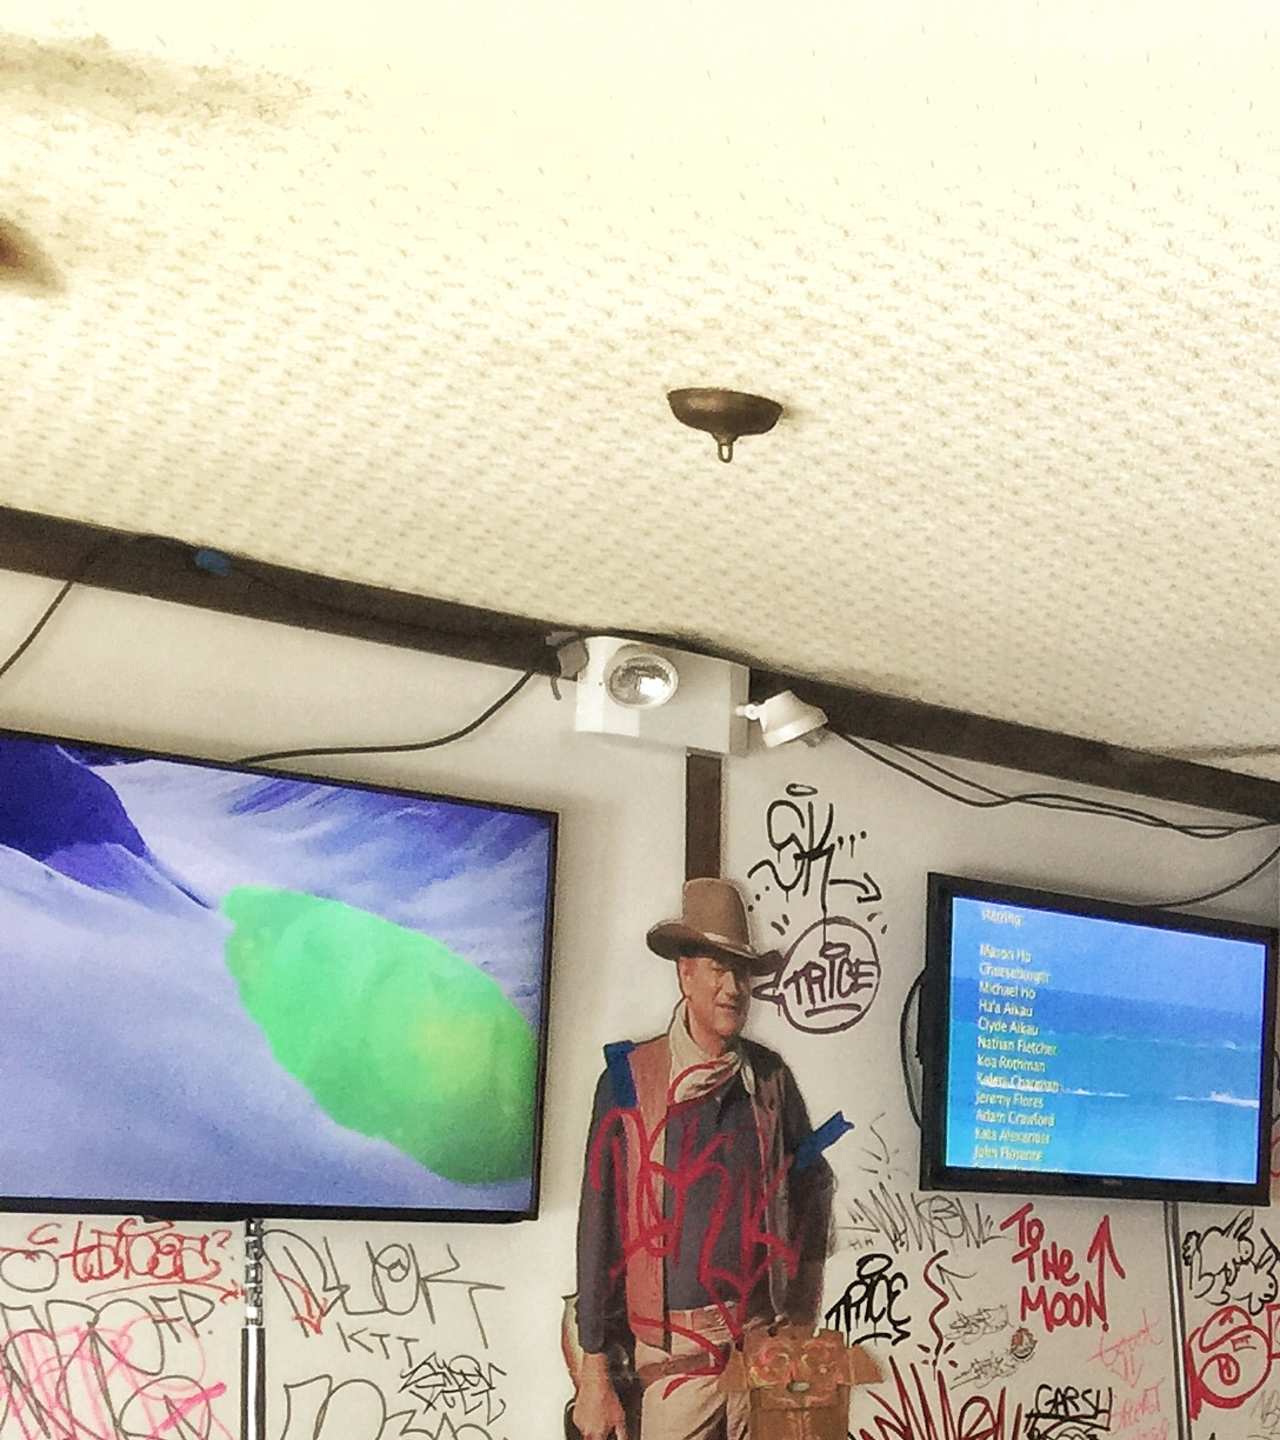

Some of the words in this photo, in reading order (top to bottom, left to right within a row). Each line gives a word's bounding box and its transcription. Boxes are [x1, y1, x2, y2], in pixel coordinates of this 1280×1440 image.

[979, 980, 1018, 997] Michael
[1021, 985, 1036, 1000] Ho
[978, 1016, 1007, 1034] Clyde
[1009, 1021, 1040, 1036] Aikau
[977, 1035, 1014, 1050] Nathan
[1017, 1039, 1057, 1055] Fletcher
[999, 1056, 1046, 1072] Rothman
[975, 1092, 1012, 1109] Jeremy
[1014, 1093, 1044, 1109] Flores
[1008, 1111, 1055, 1127] Crawford
[1000, 1203, 1045, 1247] TO
